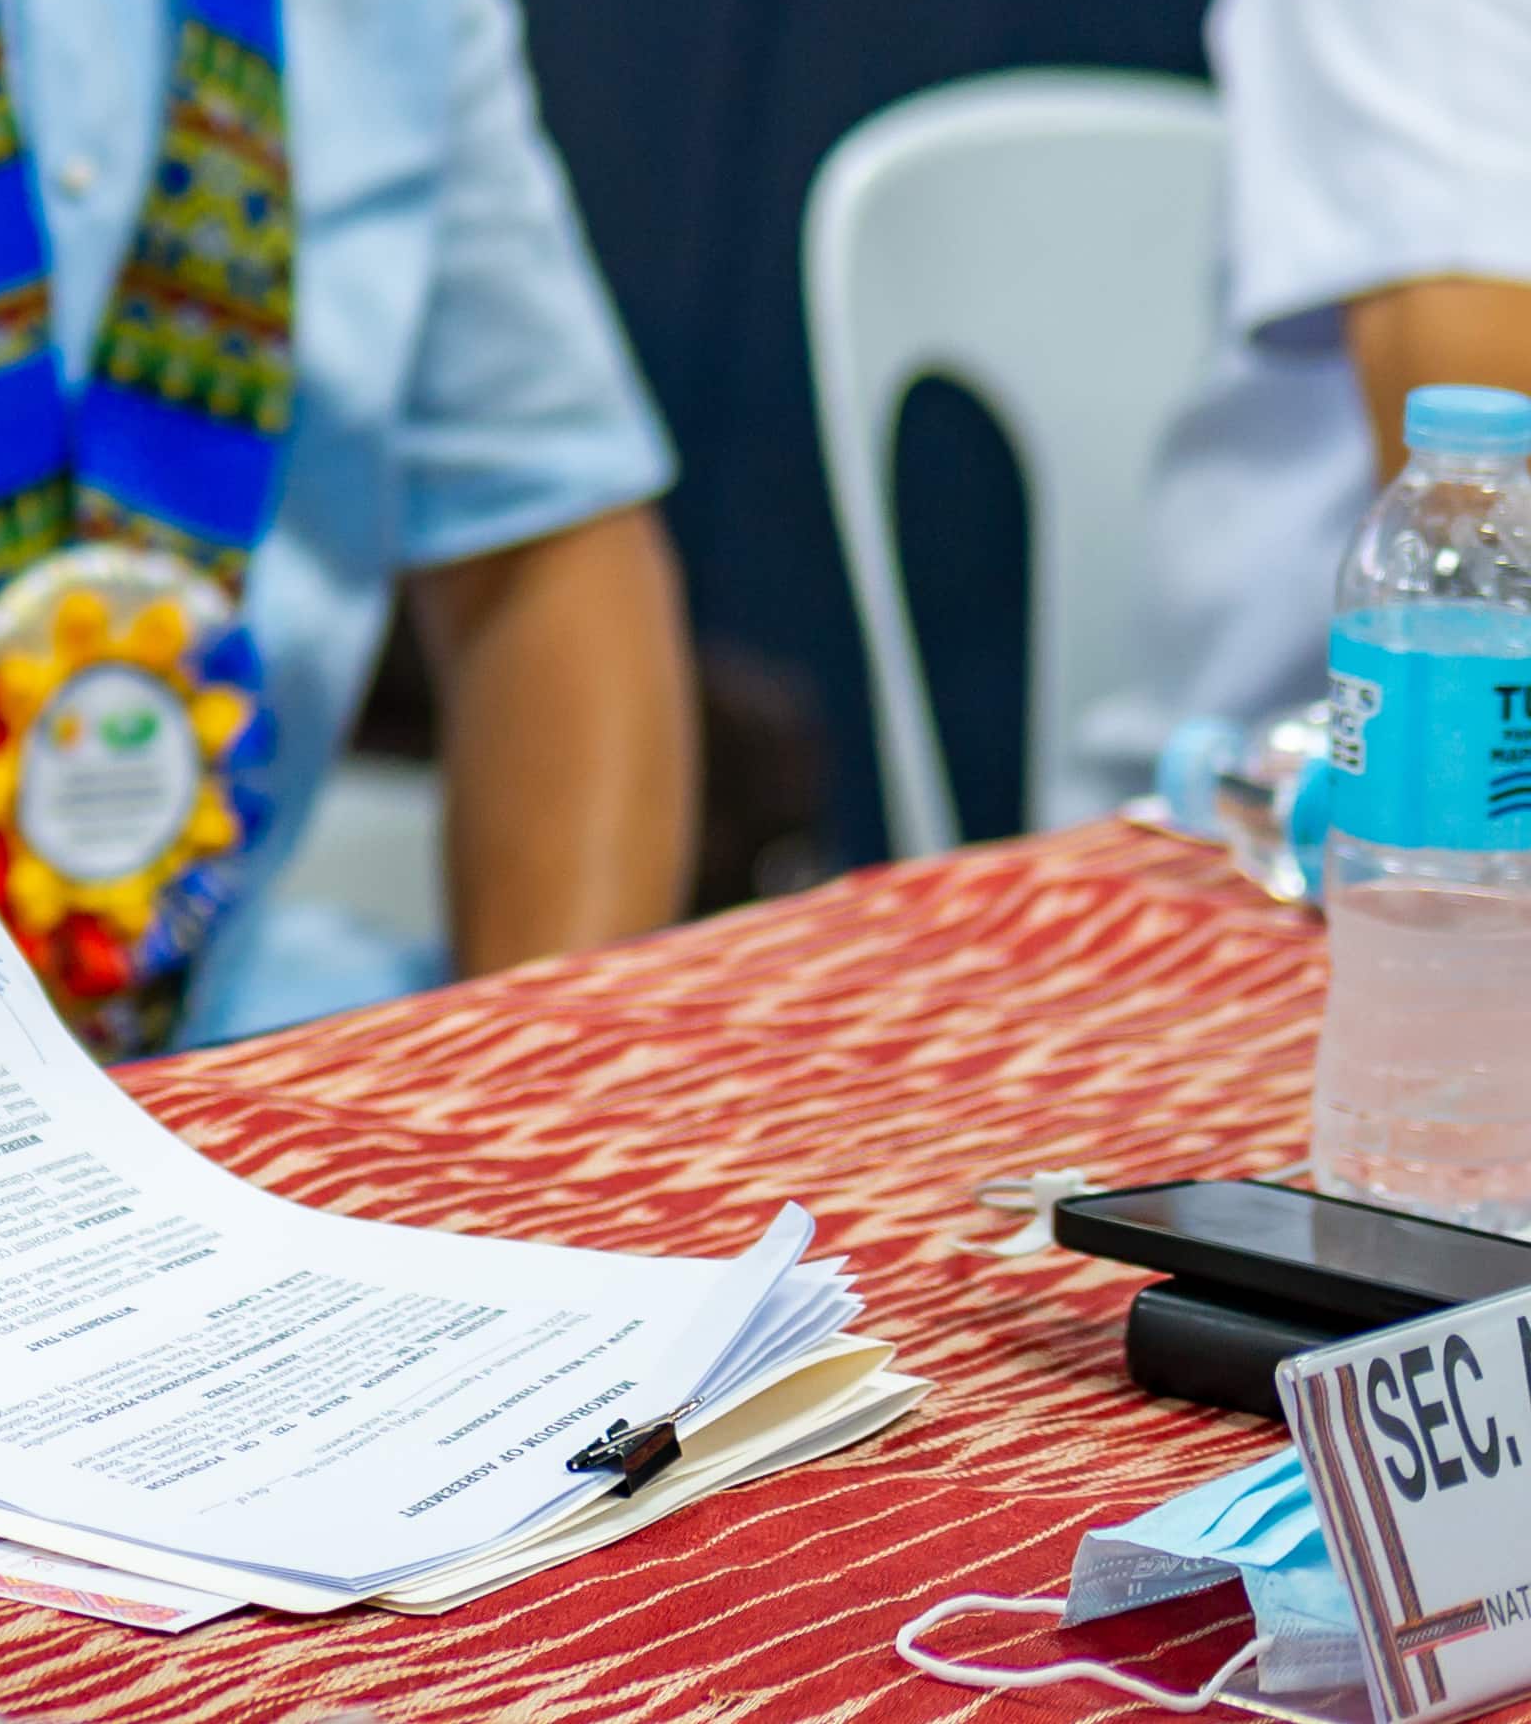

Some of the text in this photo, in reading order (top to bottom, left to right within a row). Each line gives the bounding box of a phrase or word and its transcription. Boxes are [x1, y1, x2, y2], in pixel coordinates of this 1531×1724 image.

[398, 1380, 638, 1518] MEMORANDUM OF AGREEMENT
[1367, 1334, 1522, 1502] SEC.
